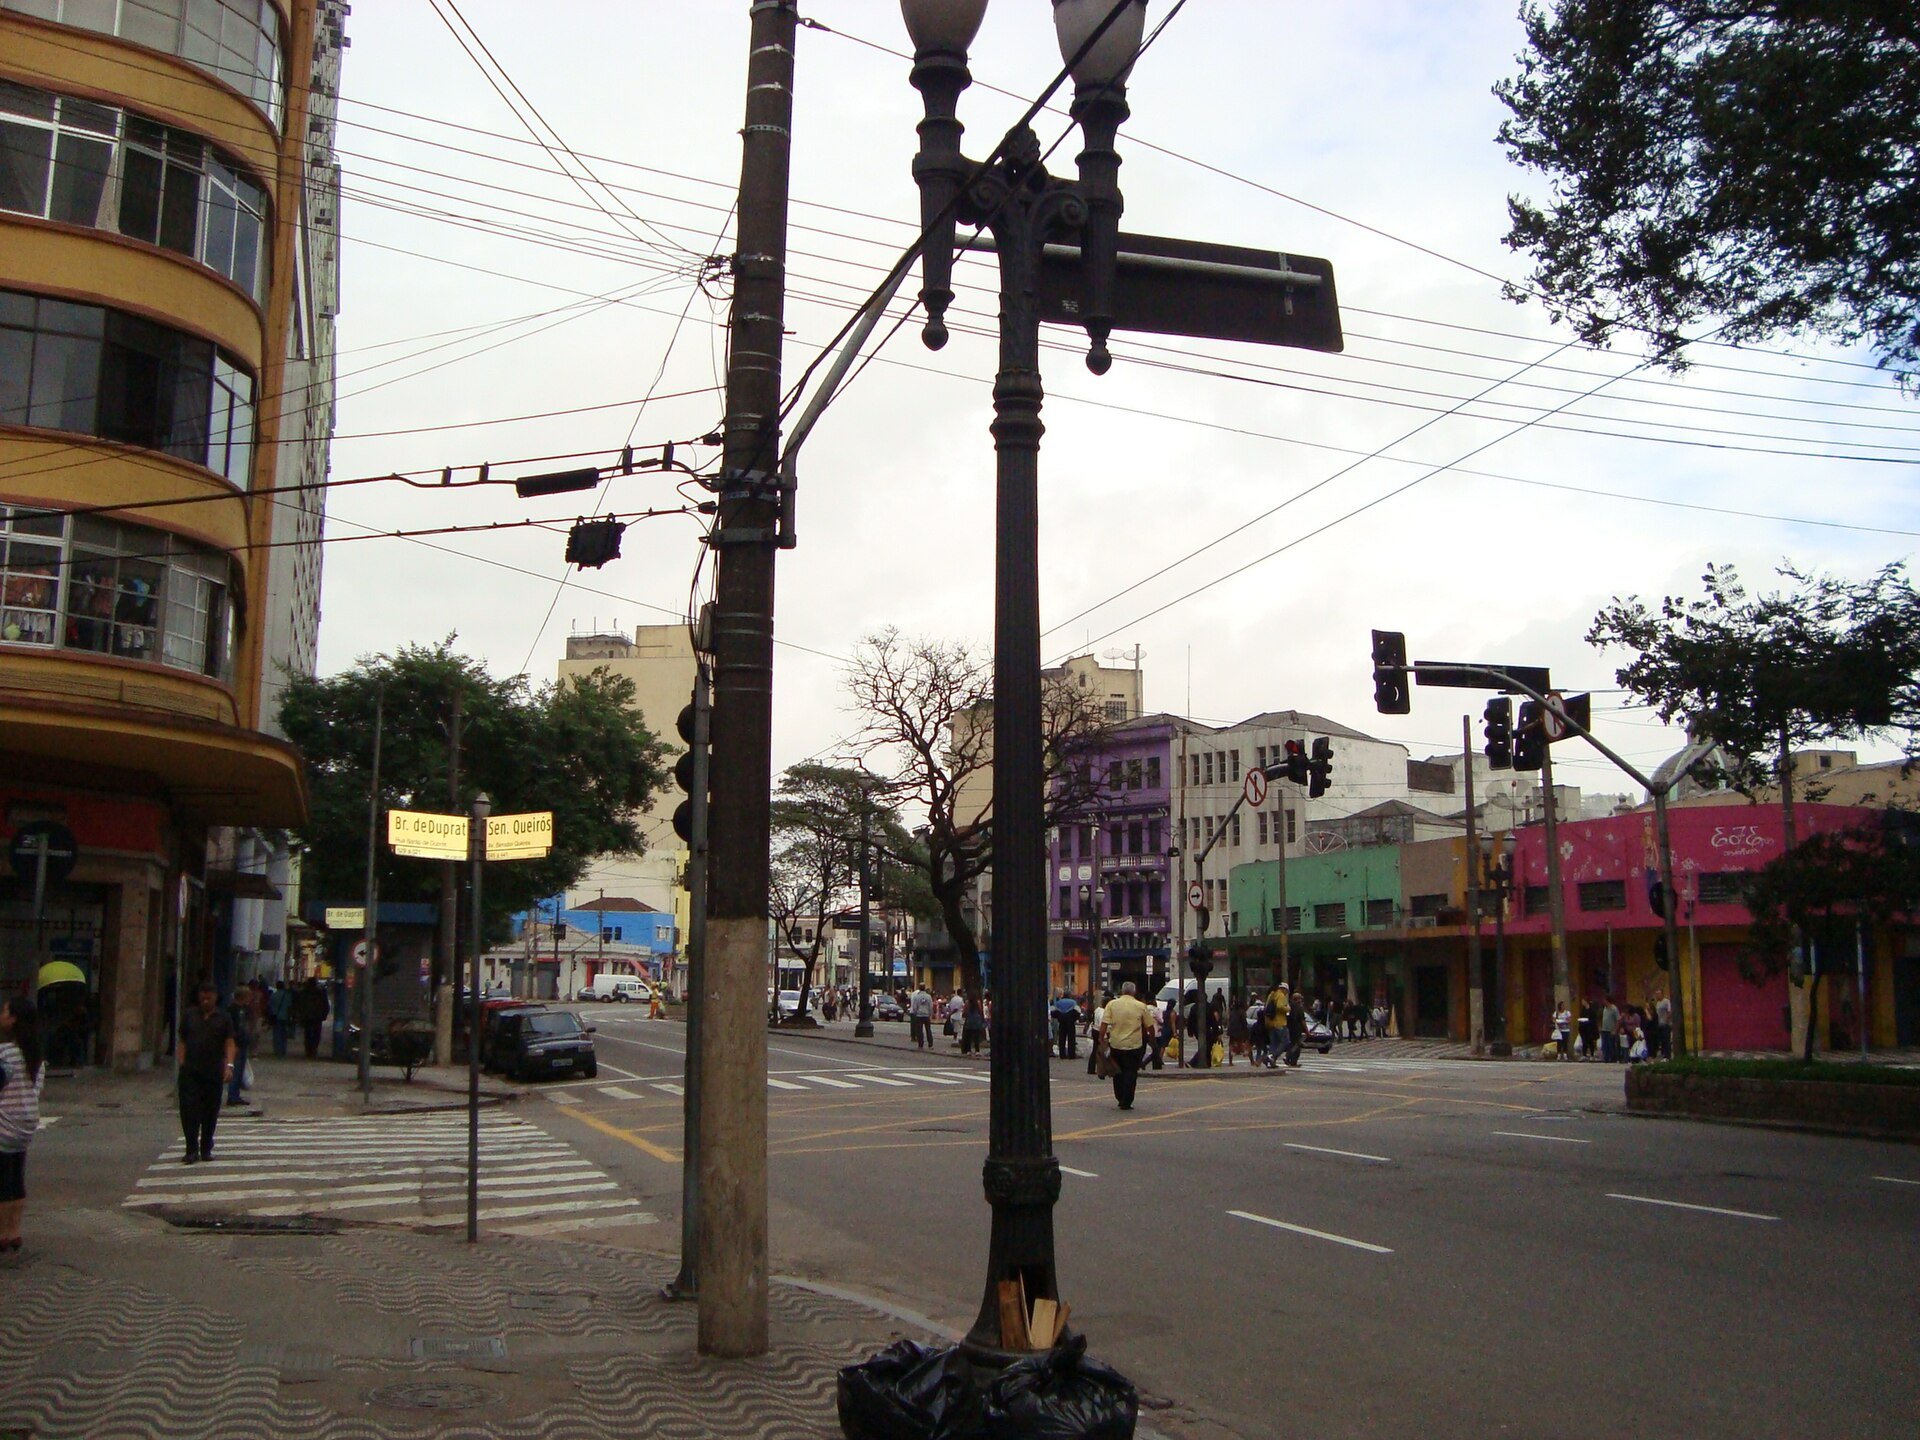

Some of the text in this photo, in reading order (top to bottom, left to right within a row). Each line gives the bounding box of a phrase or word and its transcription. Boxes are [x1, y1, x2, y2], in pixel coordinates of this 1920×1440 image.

[395, 816, 409, 831] Br.
[428, 819, 466, 838] Duprat
[488, 816, 551, 836] Sen. Queirós
